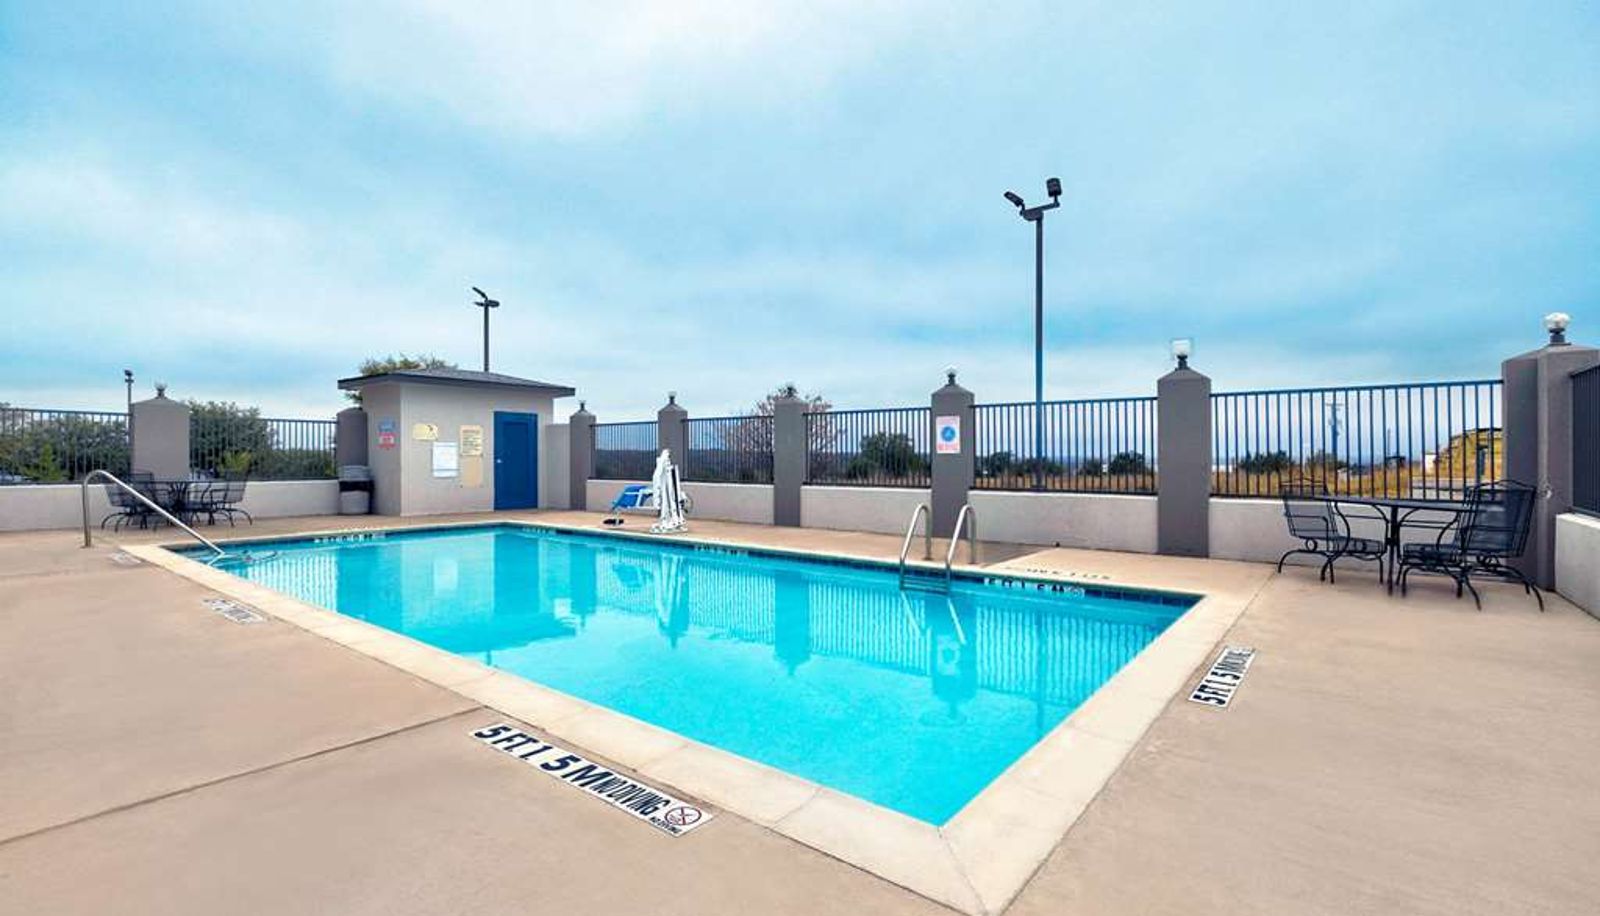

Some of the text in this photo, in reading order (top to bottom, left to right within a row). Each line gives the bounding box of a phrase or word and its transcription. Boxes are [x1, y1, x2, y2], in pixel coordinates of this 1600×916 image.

[1193, 694, 1226, 705] 5
[474, 725, 512, 739] 5
[561, 764, 615, 788] M
[606, 784, 671, 816] DIVING
